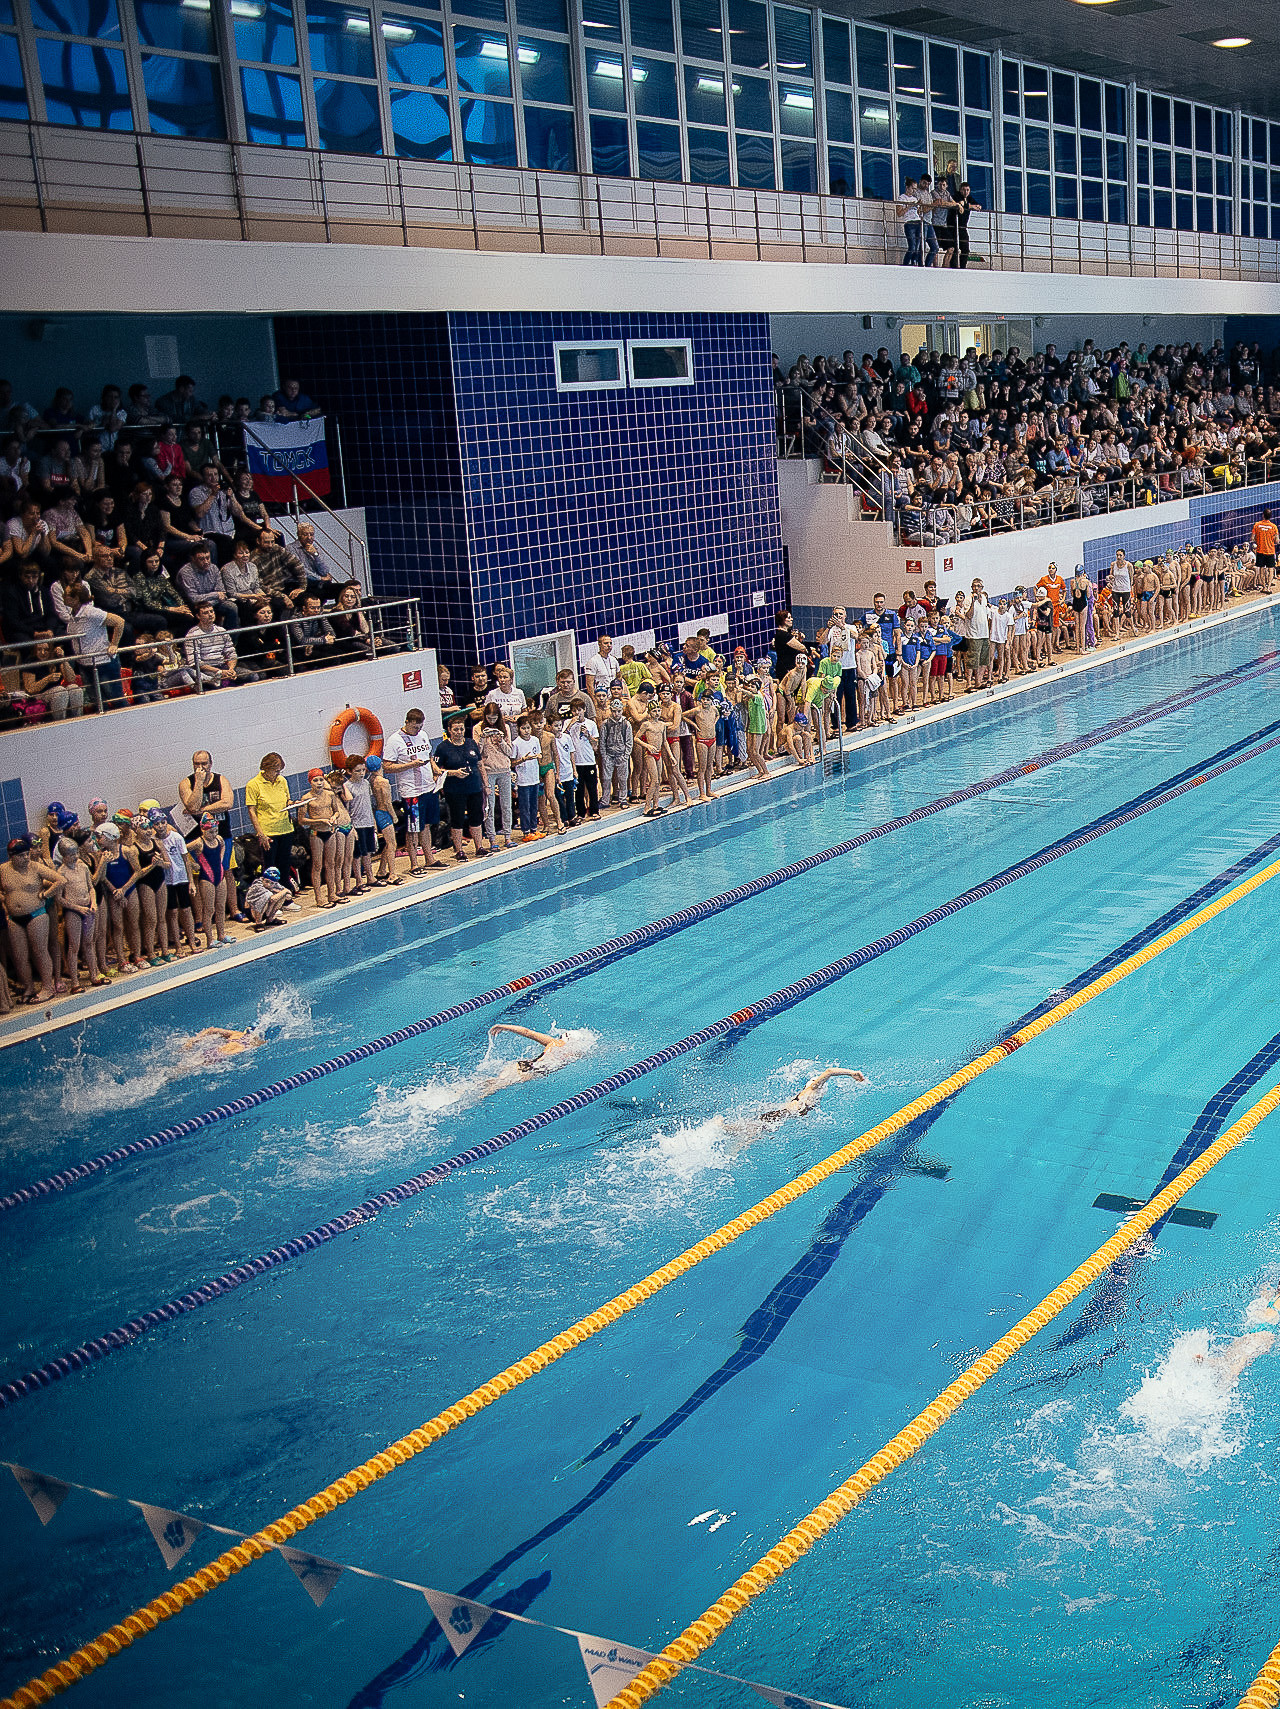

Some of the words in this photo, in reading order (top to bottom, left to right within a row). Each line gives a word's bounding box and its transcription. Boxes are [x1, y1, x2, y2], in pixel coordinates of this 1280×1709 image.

[259, 446, 316, 472] ТОМСК
[584, 1648, 606, 1658] MAD
[618, 1656, 643, 1668] WAVE
